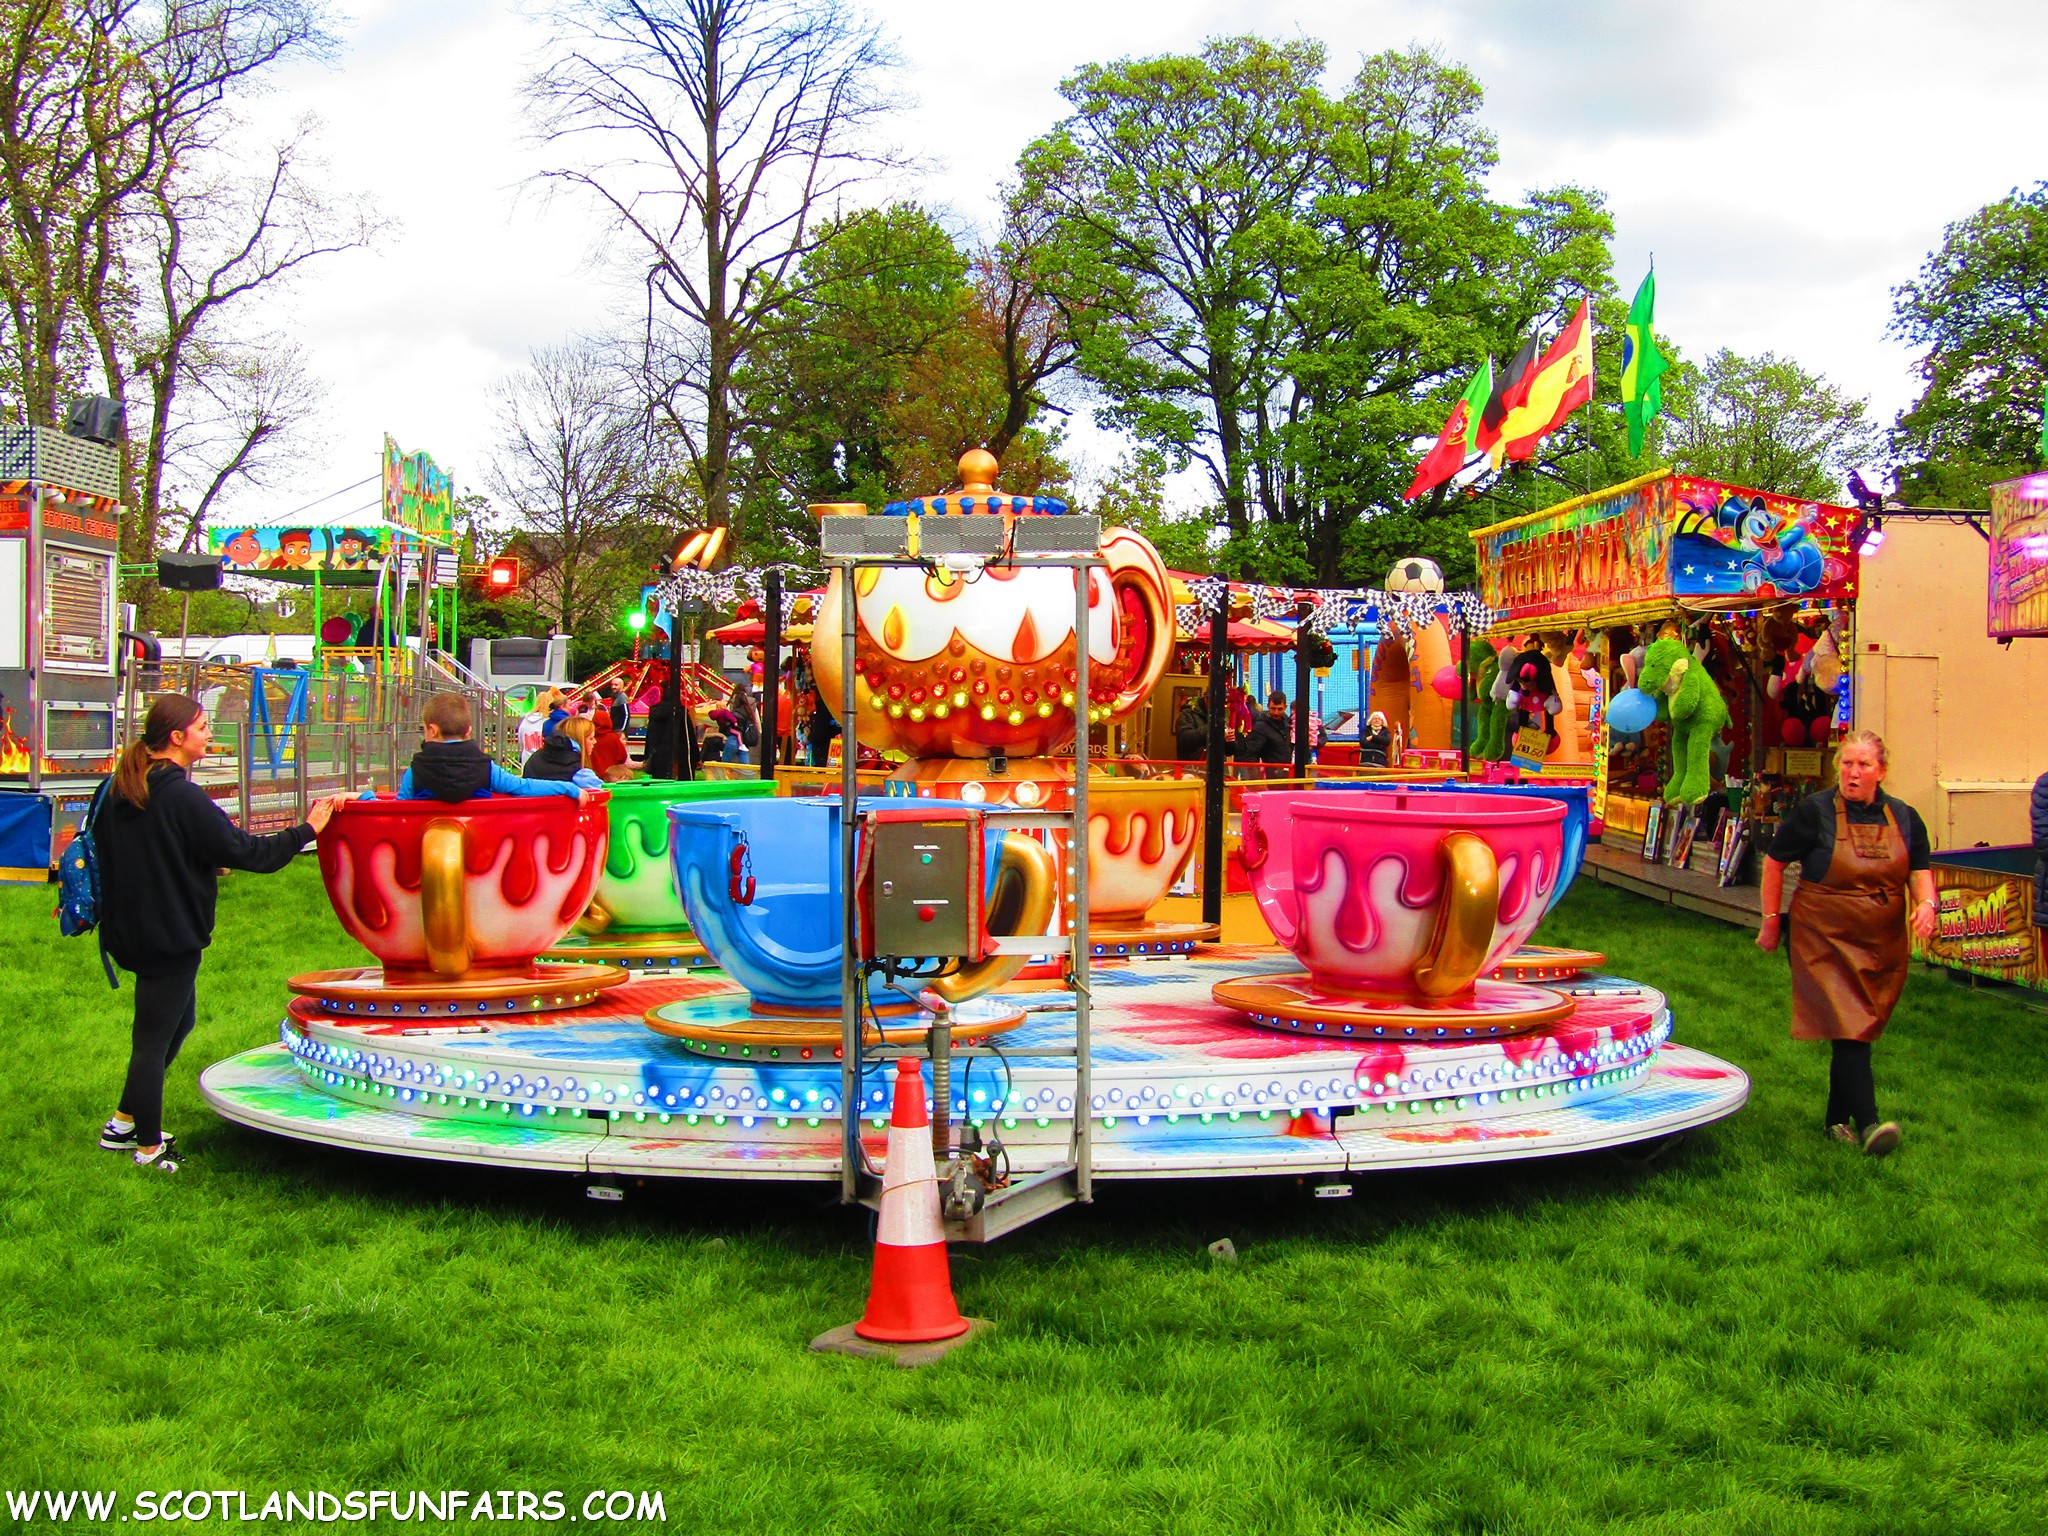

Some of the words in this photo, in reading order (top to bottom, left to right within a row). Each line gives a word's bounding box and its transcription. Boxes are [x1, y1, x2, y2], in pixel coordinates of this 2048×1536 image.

[42, 509, 84, 534] CONTROL
[1941, 890, 1960, 911] THE
[1941, 909, 1964, 937] BIG
[1967, 882, 2007, 935] BOOT
[1962, 942, 1982, 960] FUN
[1985, 938, 2020, 959] HOUSE
